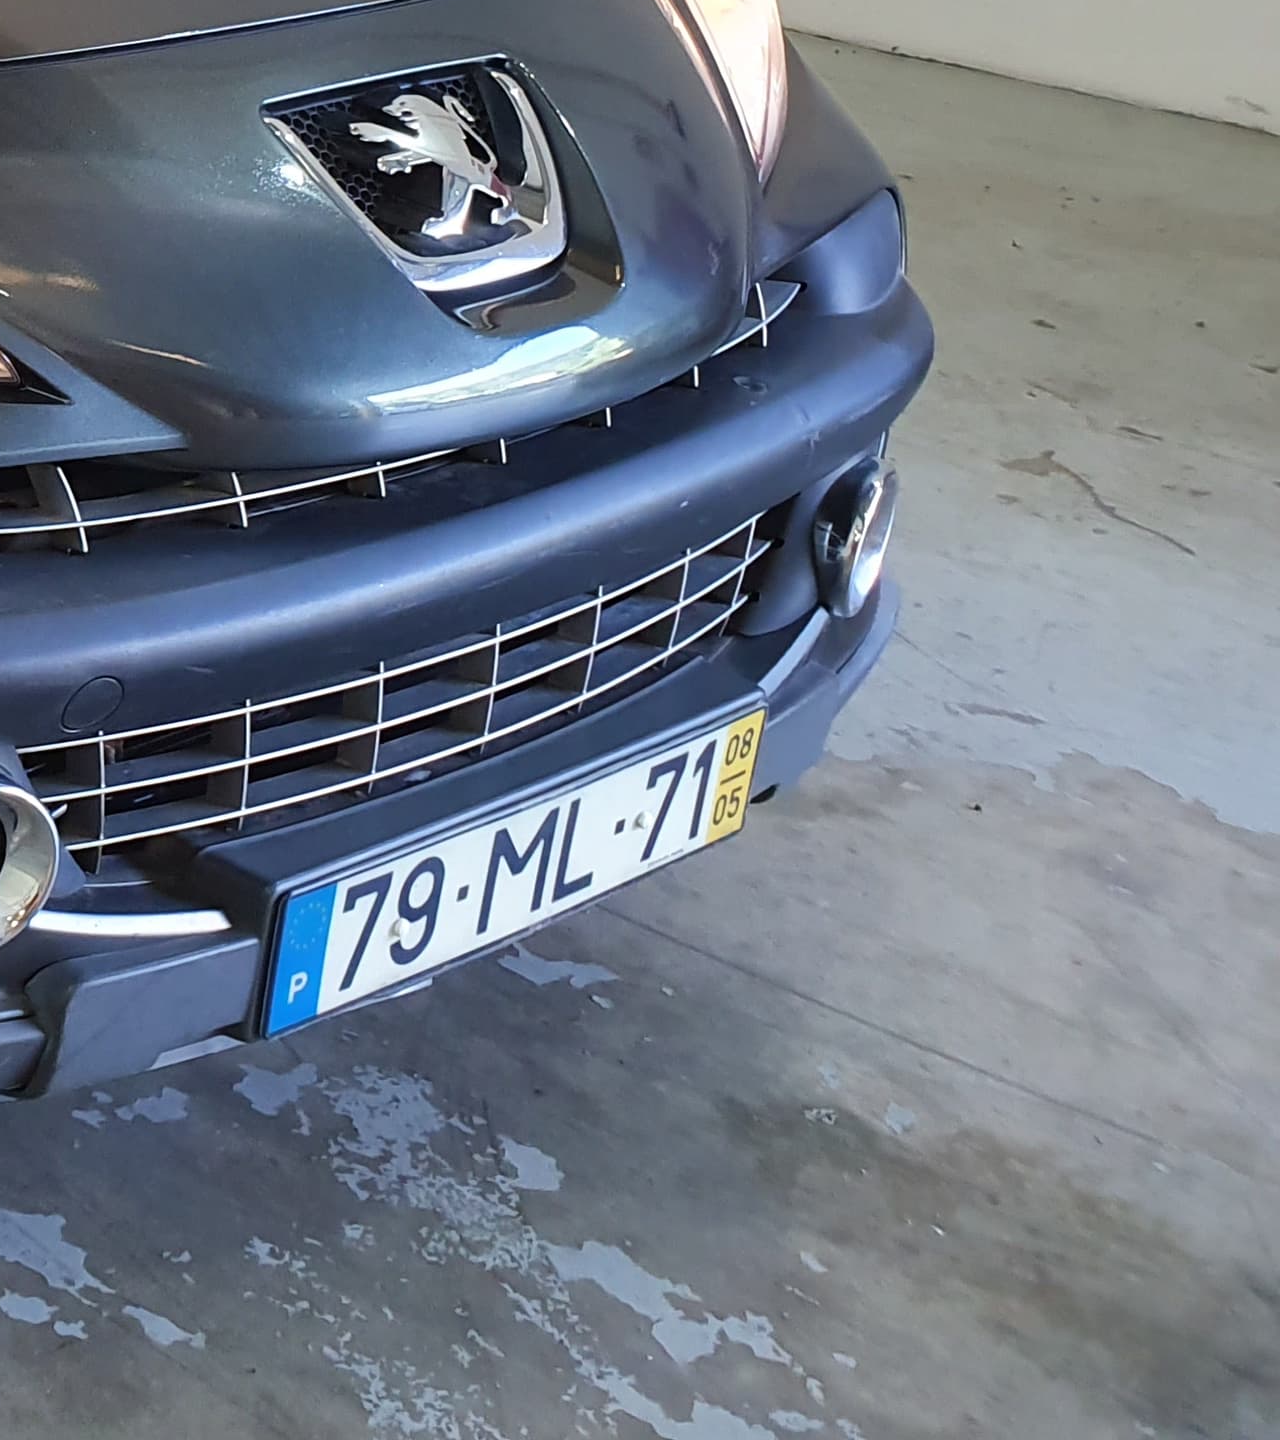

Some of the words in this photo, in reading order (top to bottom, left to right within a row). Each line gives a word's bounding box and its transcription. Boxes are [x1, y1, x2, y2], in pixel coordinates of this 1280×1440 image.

[725, 727, 755, 766] 08
[712, 786, 743, 825] 05
[287, 971, 308, 1004] P
